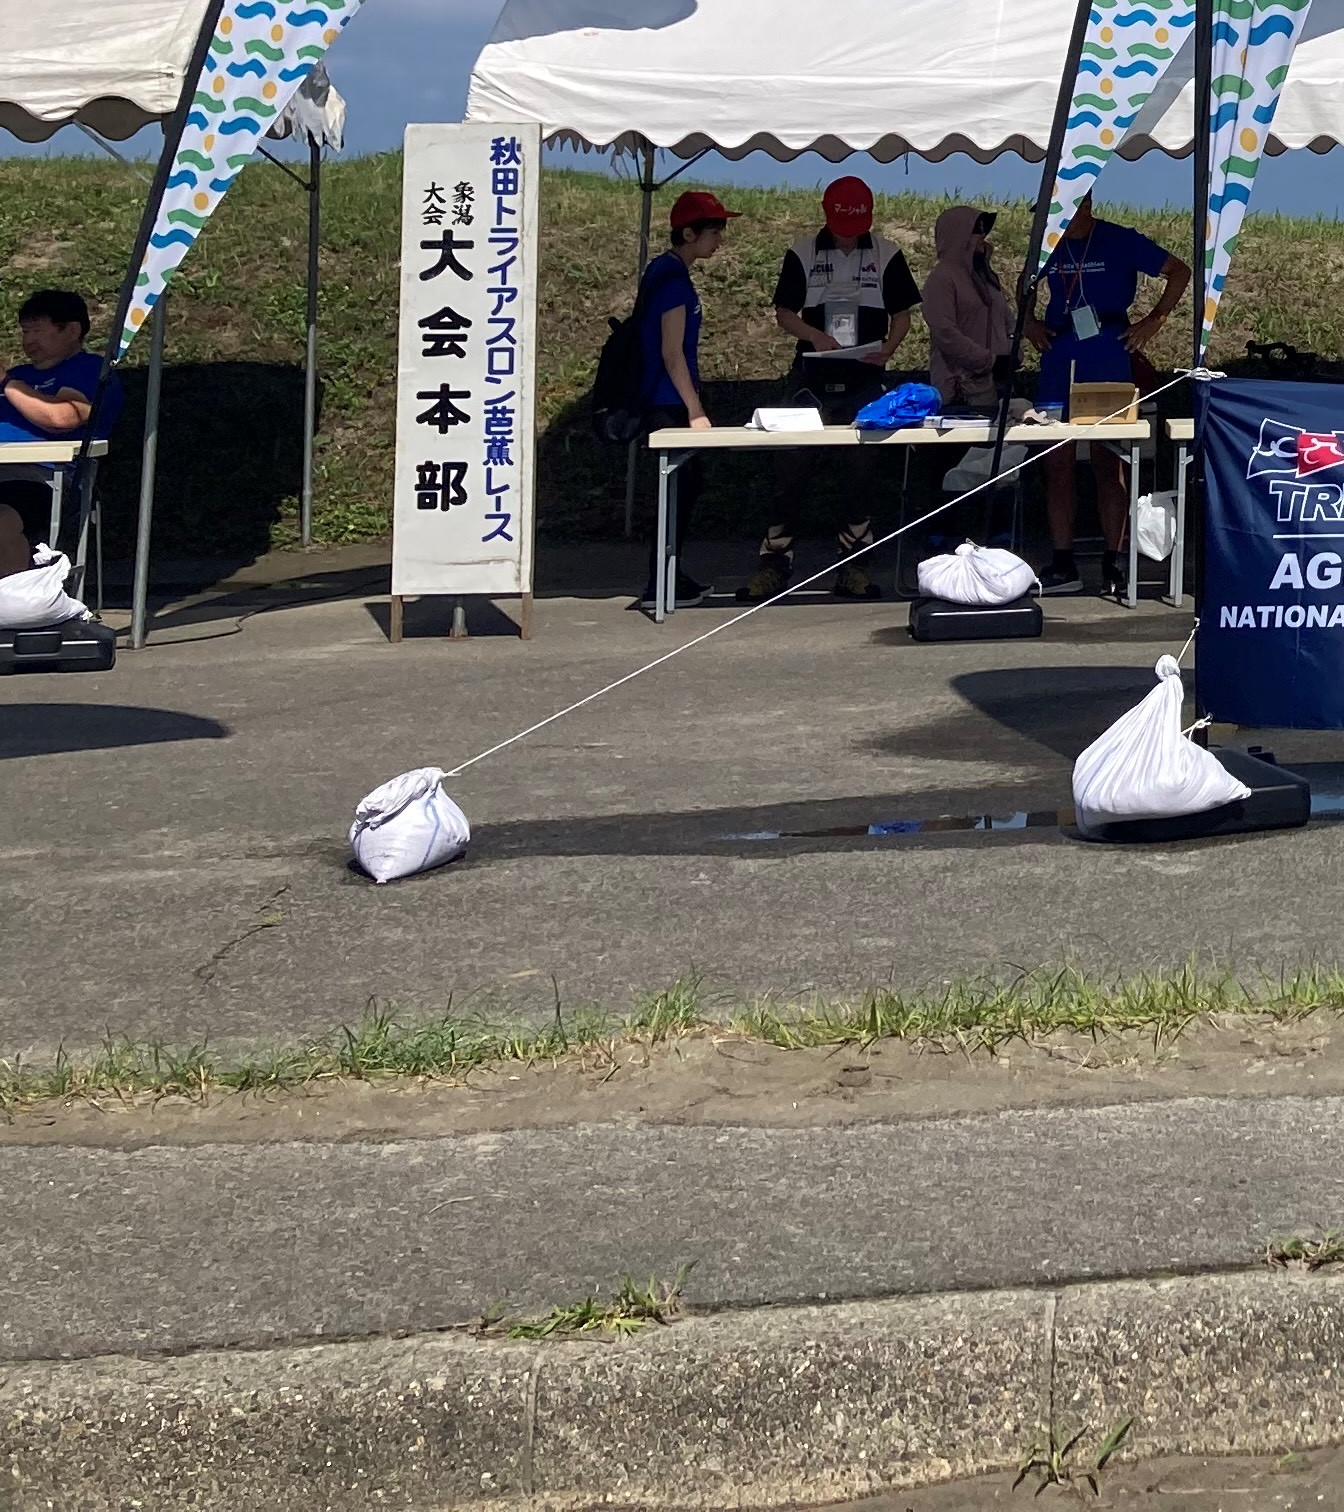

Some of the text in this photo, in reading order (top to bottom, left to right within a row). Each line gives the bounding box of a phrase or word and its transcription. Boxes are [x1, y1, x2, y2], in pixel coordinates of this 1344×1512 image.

[414, 229, 475, 513] 大会本部
[482, 136, 522, 543] 秋田トライアスロン芭蕉レース
